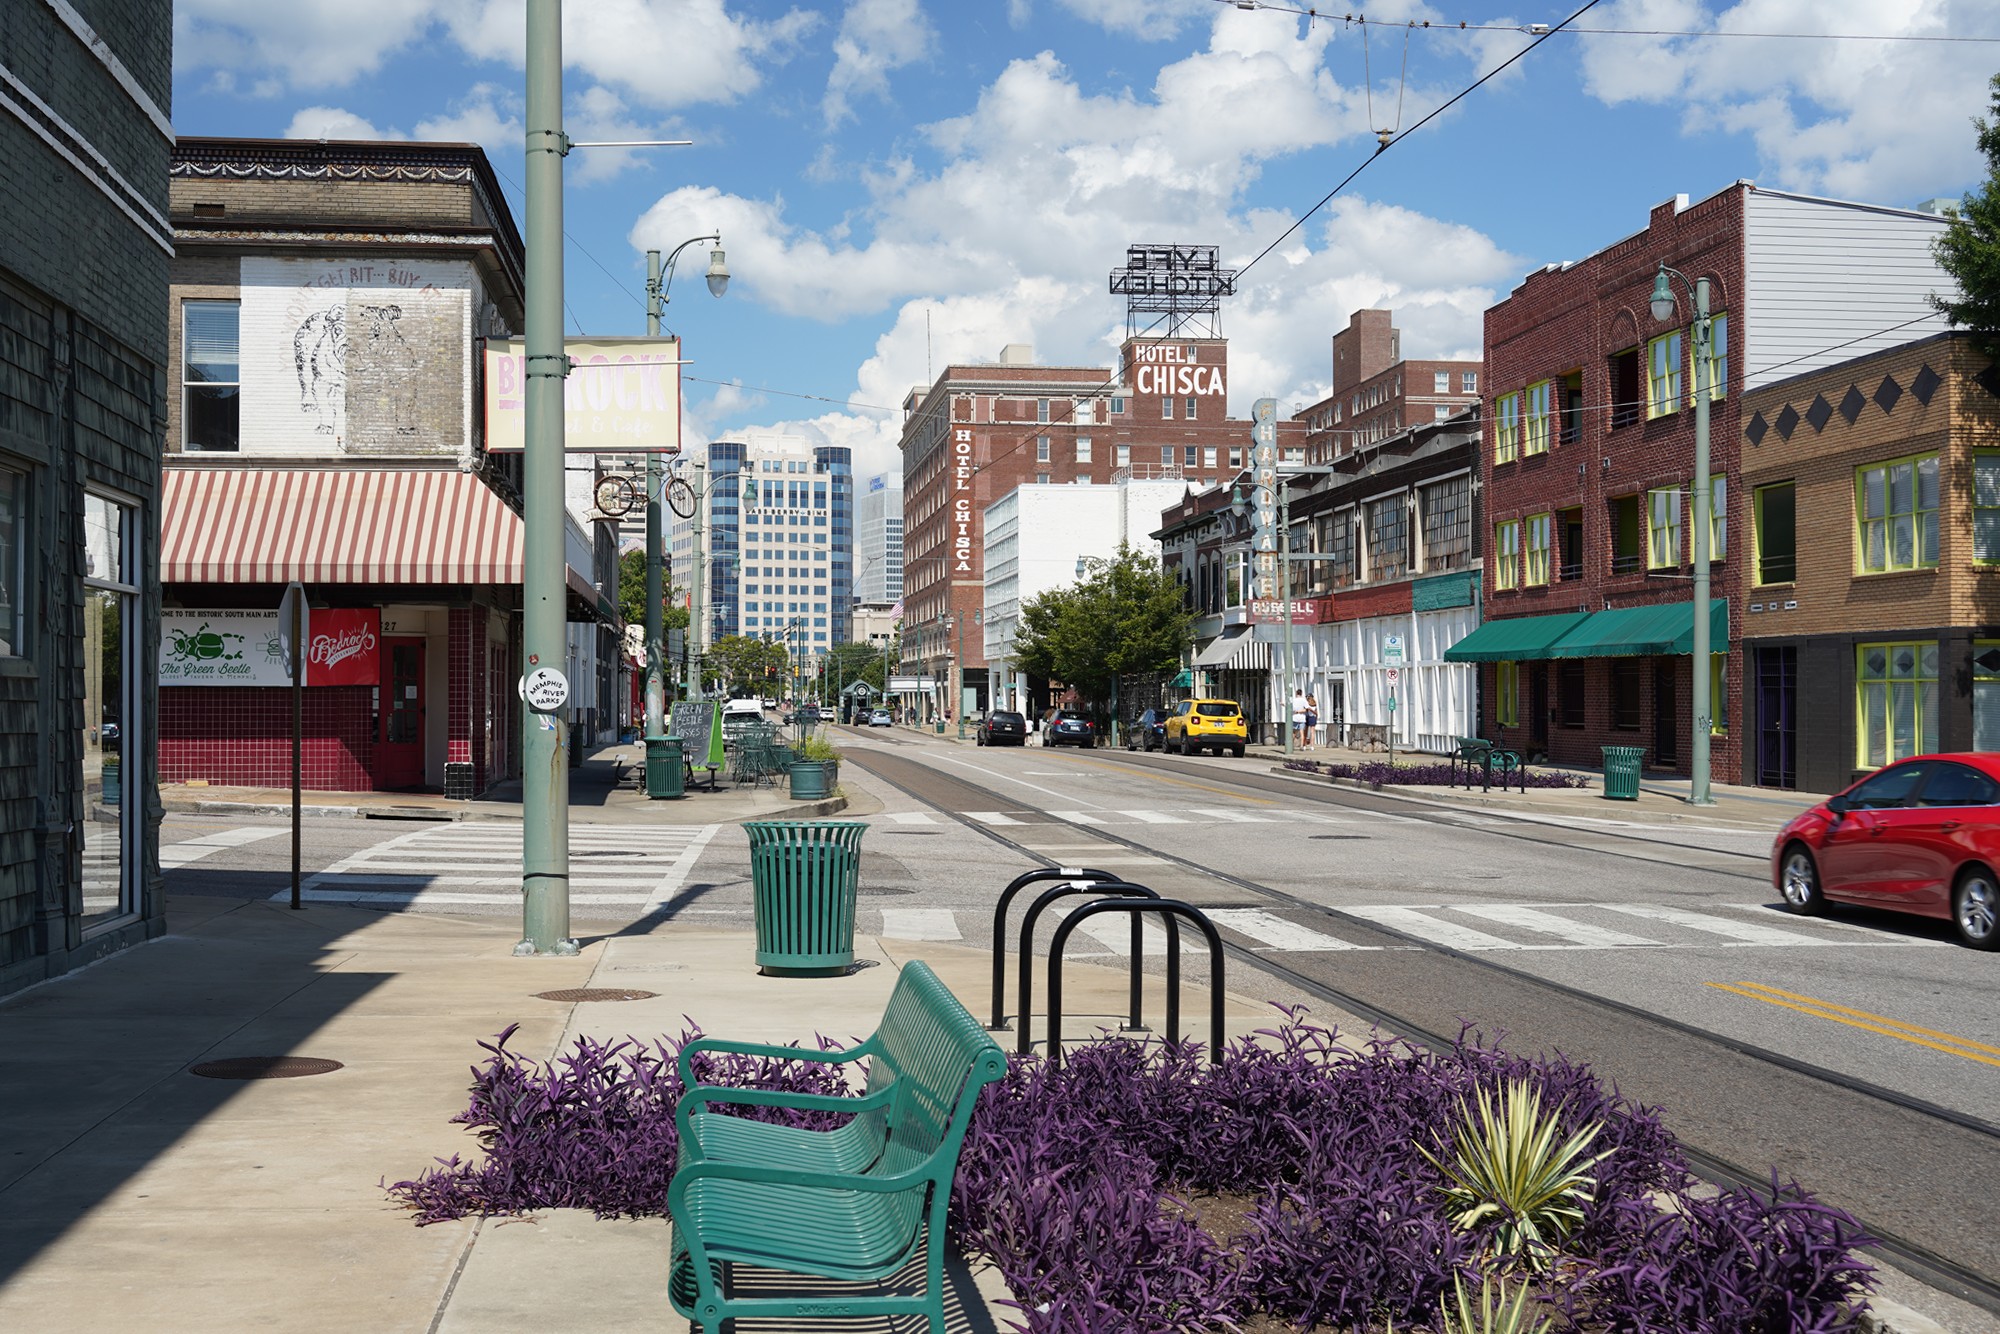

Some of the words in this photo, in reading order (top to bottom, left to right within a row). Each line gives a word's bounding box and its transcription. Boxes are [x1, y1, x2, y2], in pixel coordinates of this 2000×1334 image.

[389, 268, 420, 288] BUY
[1135, 345, 1186, 363] HOTEL
[1137, 365, 1226, 396] CHISCA
[955, 430, 972, 490] HOTEL
[955, 499, 972, 571] CHISCA
[310, 622, 376, 664] Bedrock
[159, 663, 181, 675] The
[184, 662, 215, 677] Green
[218, 662, 252, 675] Beetle
[529, 680, 563, 696] MEMPHIS
[542, 689, 566, 697] RIVER
[535, 697, 560, 705] PARKS
